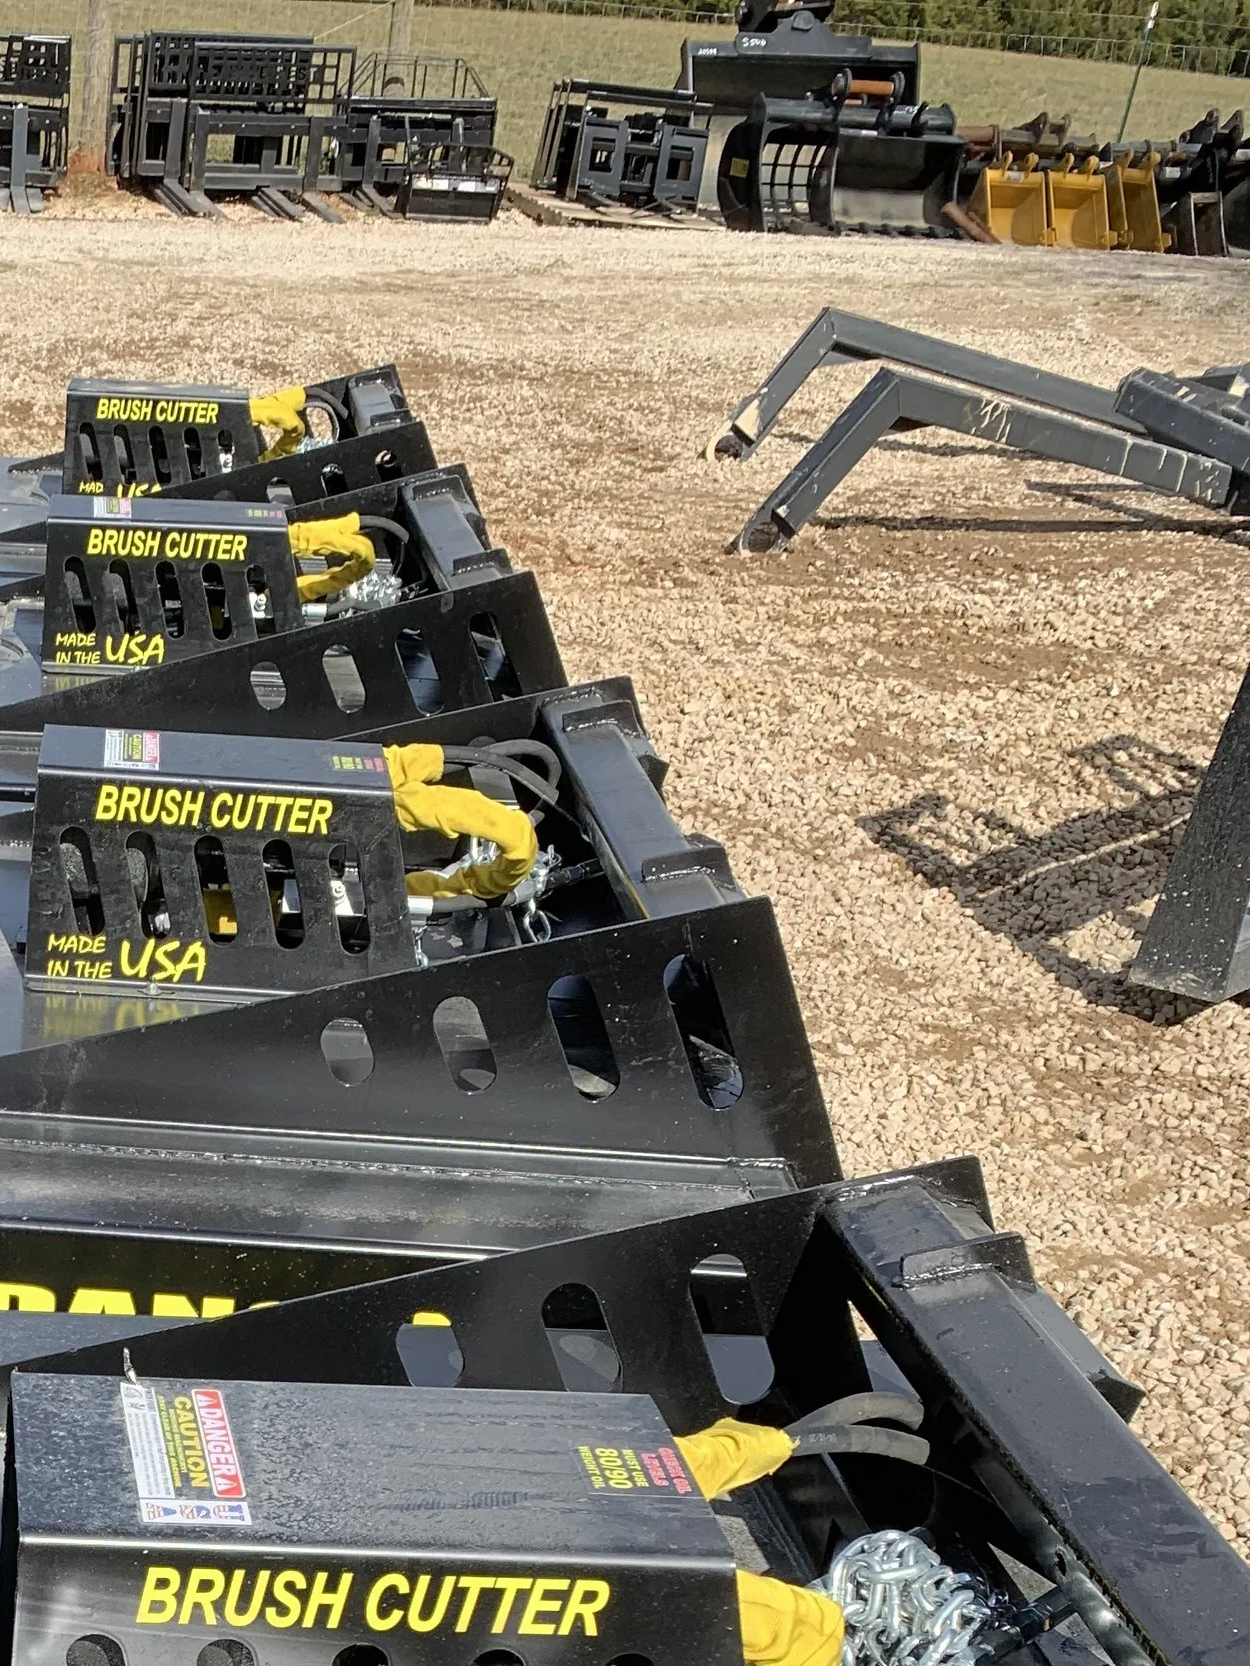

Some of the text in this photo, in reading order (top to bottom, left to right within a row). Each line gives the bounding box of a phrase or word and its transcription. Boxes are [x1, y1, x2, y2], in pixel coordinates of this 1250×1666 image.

[96, 398, 218, 425] BRUSH CUTTER
[87, 529, 247, 561] BRUSH CUTTER
[56, 632, 95, 647] MADE
[56, 651, 102, 665] IN THE
[104, 633, 164, 665] USA
[95, 784, 334, 835] BRUSH CUTTER
[48, 933, 106, 955] MADE
[120, 938, 207, 984] USA
[47, 959, 113, 981] IN THE
[174, 1396, 210, 1487] CAUTION
[199, 1407, 237, 1476] DANGER
[578, 1446, 606, 1489] WEIGHT OIL
[595, 1447, 633, 1489] 80/90
[622, 1449, 649, 1487] MUST USE
[134, 1567, 610, 1637] BRUSH CUTTER
